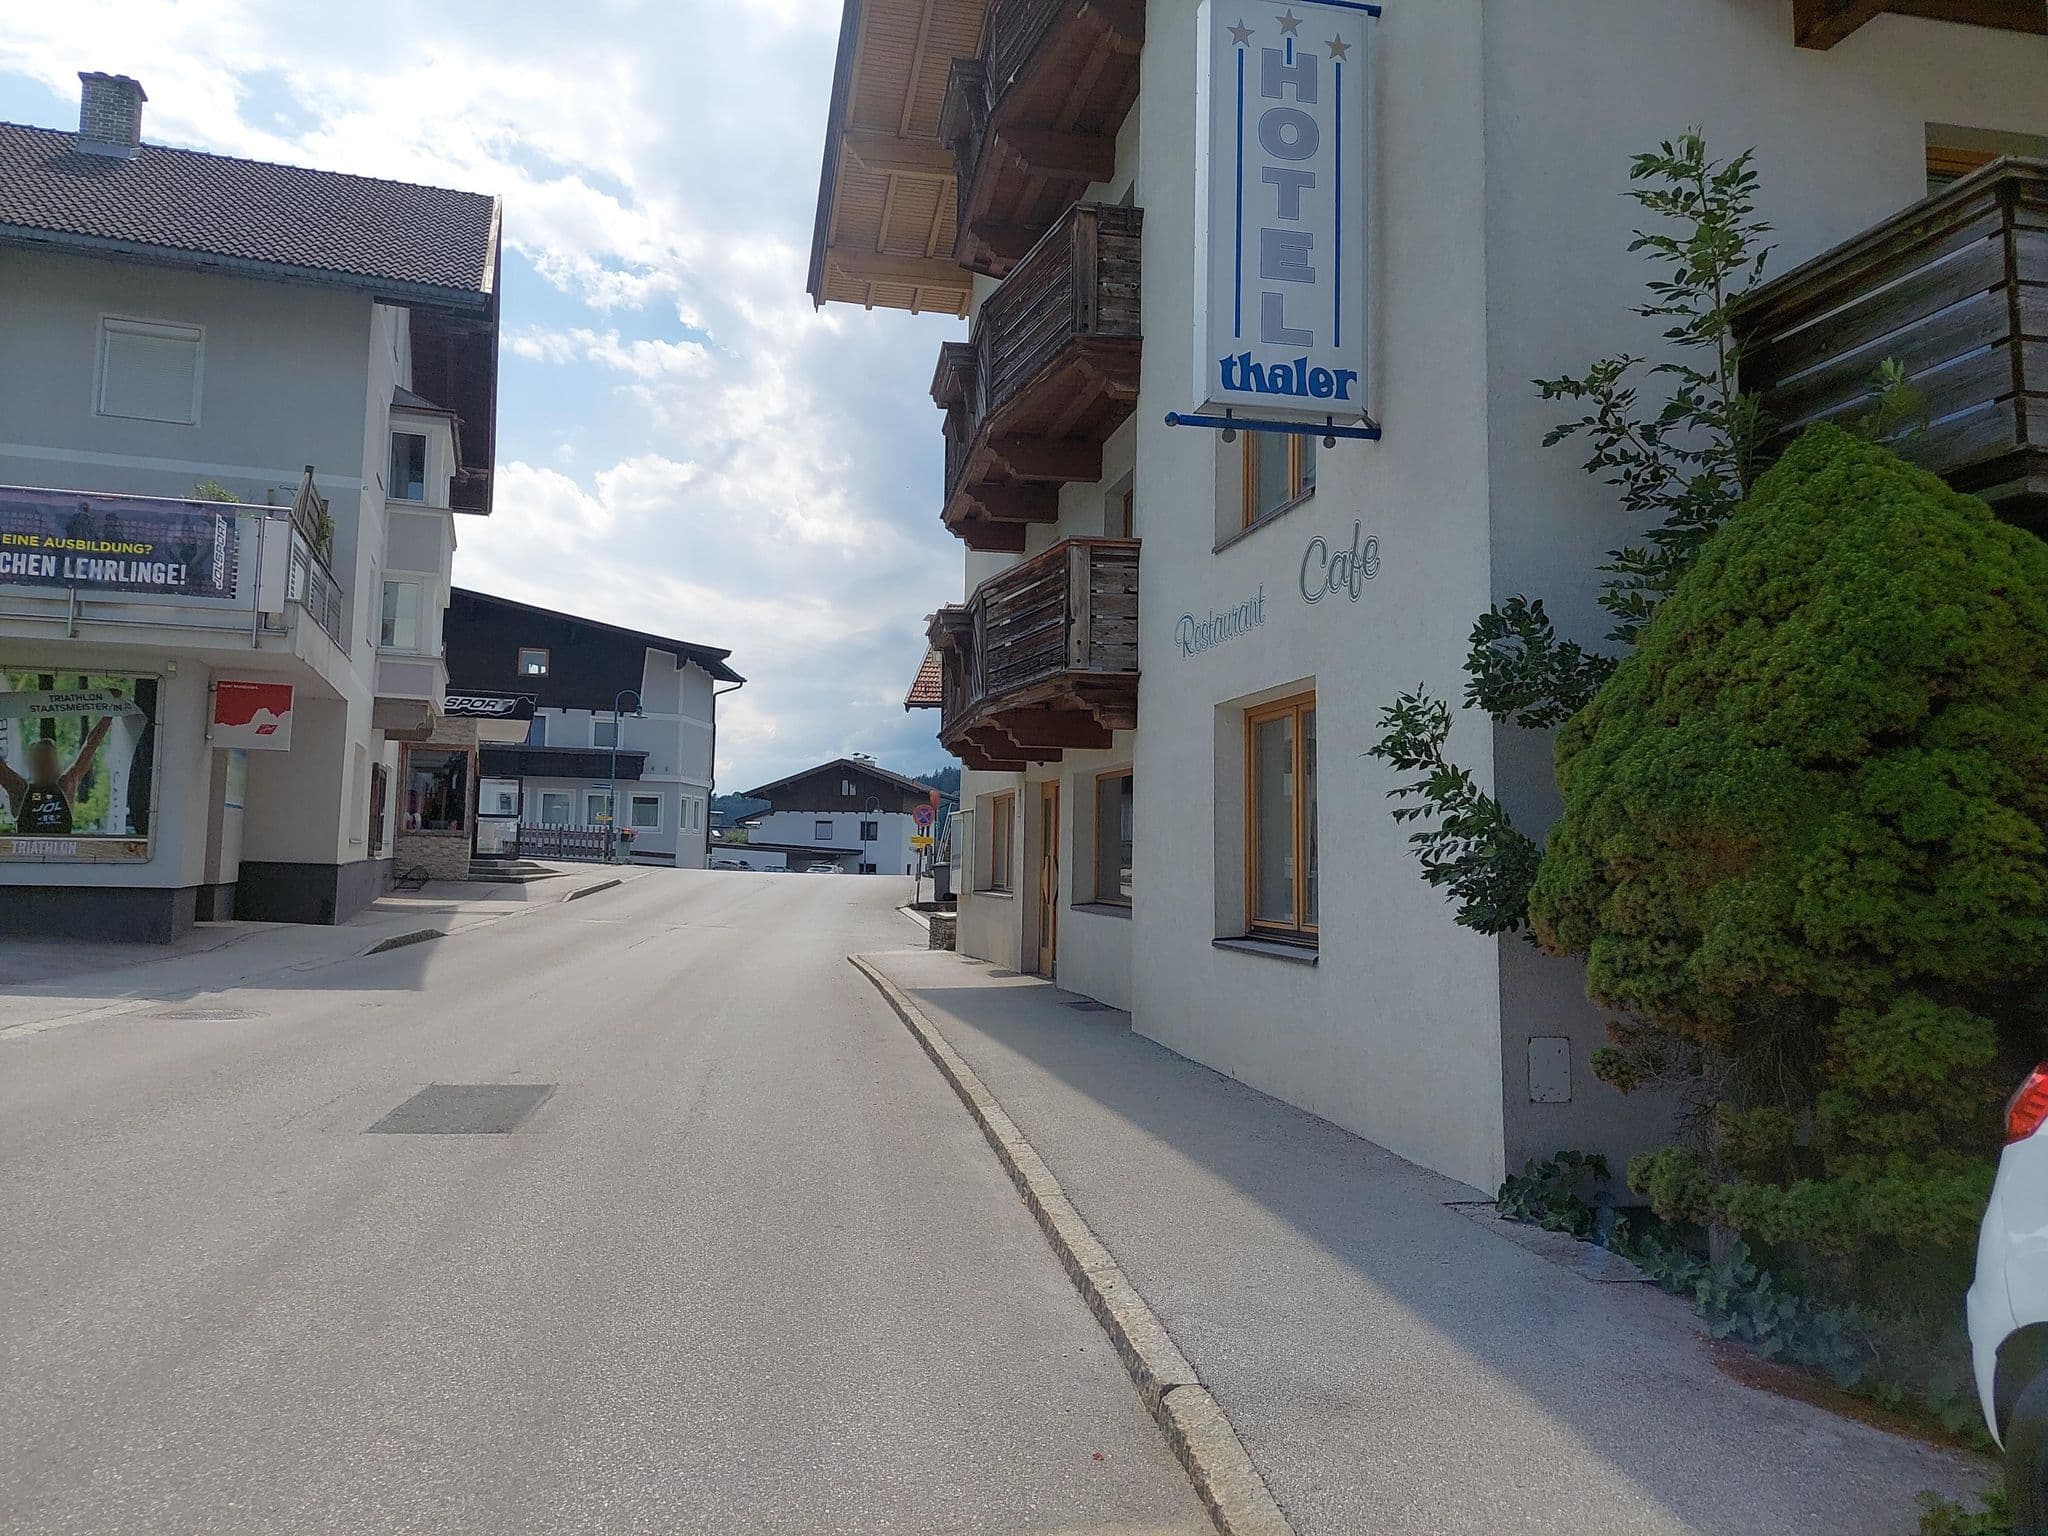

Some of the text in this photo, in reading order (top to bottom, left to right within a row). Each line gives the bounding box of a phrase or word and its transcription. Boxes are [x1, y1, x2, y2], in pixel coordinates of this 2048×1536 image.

[1259, 47, 1319, 347] HOTEL
[1218, 351, 1358, 401] thaler
[2, 533, 153, 555] EINE AUSBILDUNG?
[63, 556, 187, 586] LEHRLINGE!
[1299, 519, 1381, 604] Cafe
[1175, 583, 1266, 659] Restaurant
[49, 693, 102, 703] TRIATHLON
[32, 801, 62, 813] JOL
[11, 840, 77, 855] TRIATHLON
